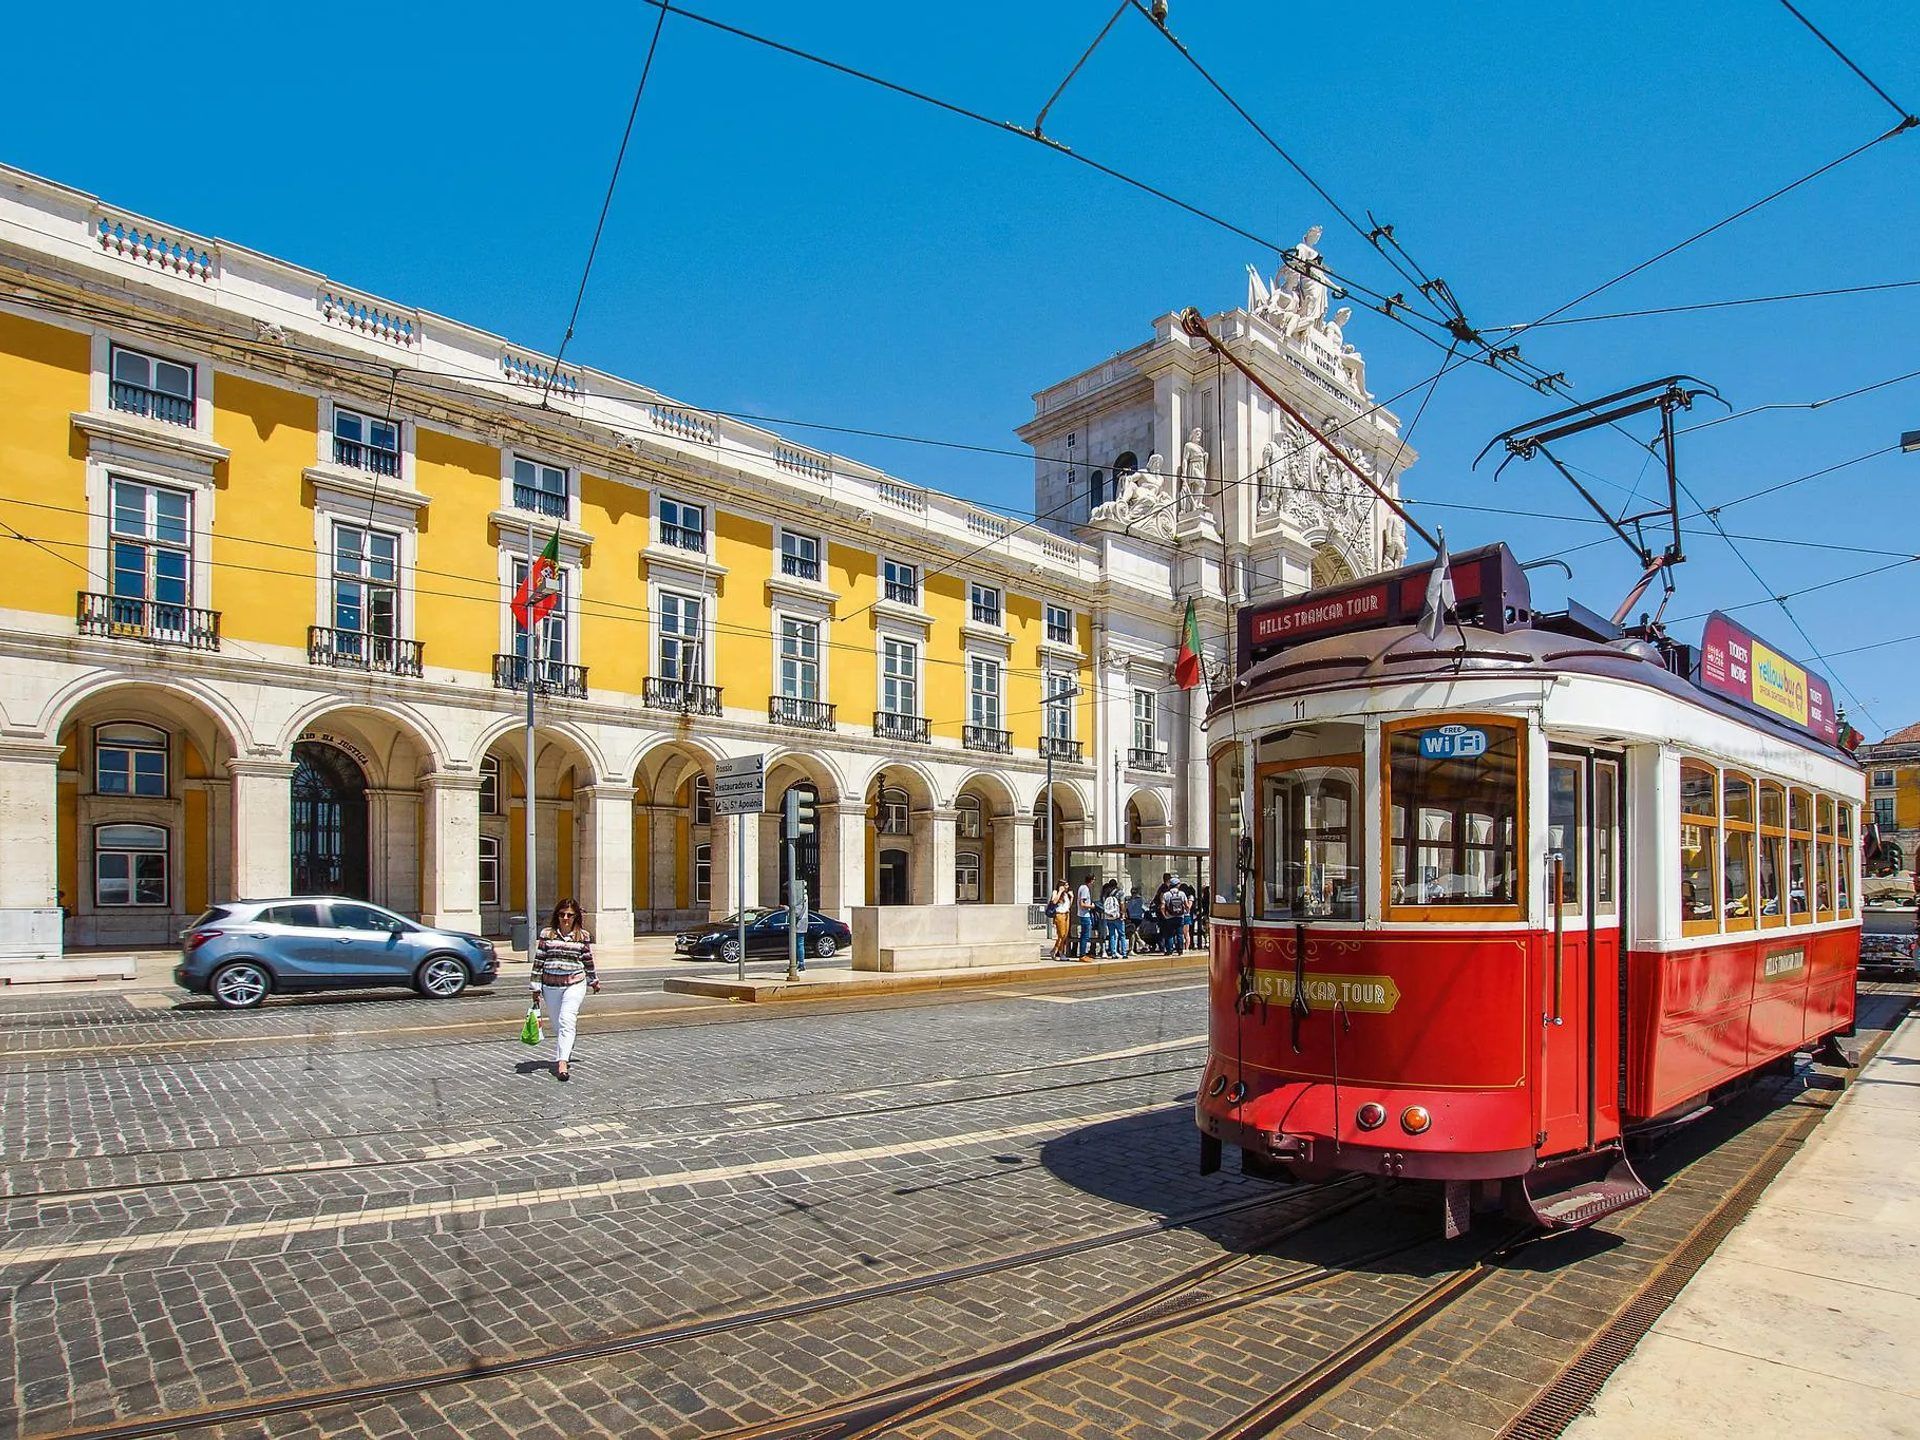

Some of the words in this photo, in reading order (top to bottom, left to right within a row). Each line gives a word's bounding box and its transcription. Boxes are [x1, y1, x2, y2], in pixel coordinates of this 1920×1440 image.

[1259, 616, 1292, 635] HILLS
[1294, 602, 1344, 627] TRAMCAR
[1347, 594, 1379, 616] TOUR
[1293, 699, 1305, 719] 11
[715, 781, 753, 792] Restauradores
[1342, 982, 1386, 1004] TOUR
